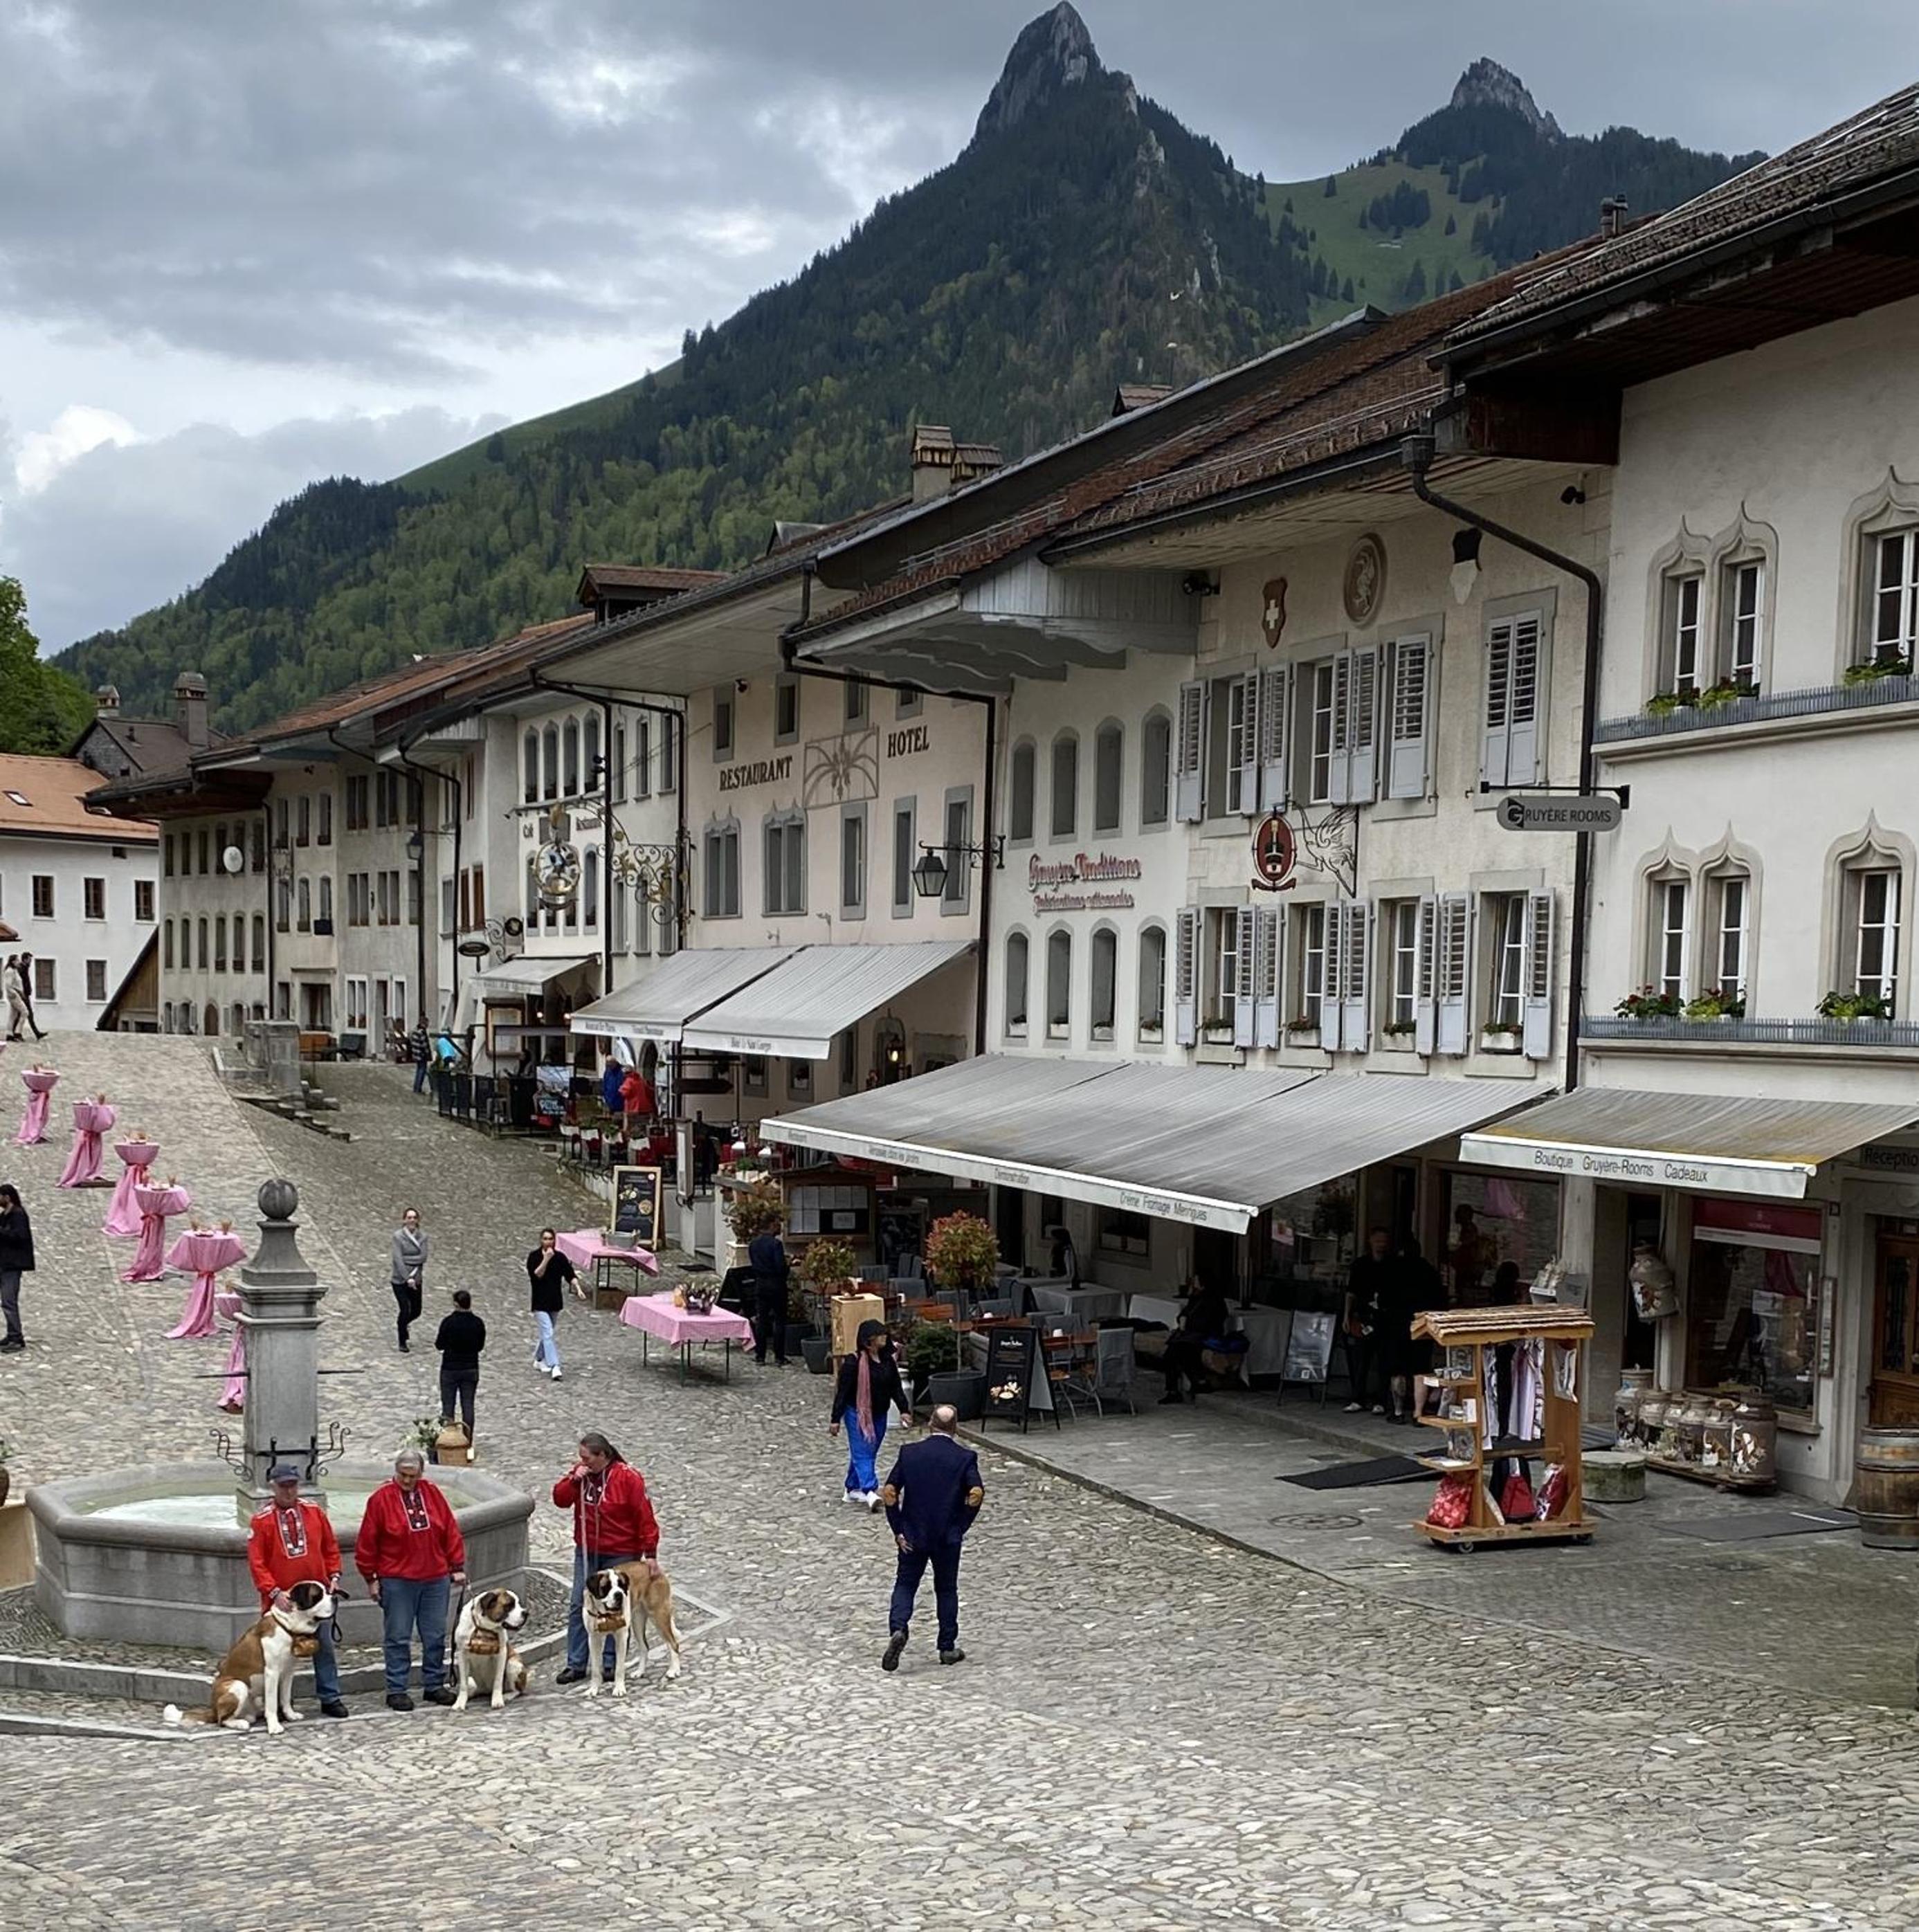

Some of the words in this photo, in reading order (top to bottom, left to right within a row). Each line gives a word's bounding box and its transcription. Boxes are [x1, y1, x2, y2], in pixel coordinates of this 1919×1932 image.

[887, 725, 930, 758] HOTEL
[719, 756, 792, 791] RESTAURANT
[1570, 810, 1612, 823] ROOMS
[1534, 1150, 1574, 1168] Boutique
[1664, 1163, 1708, 1183] Cadeaux
